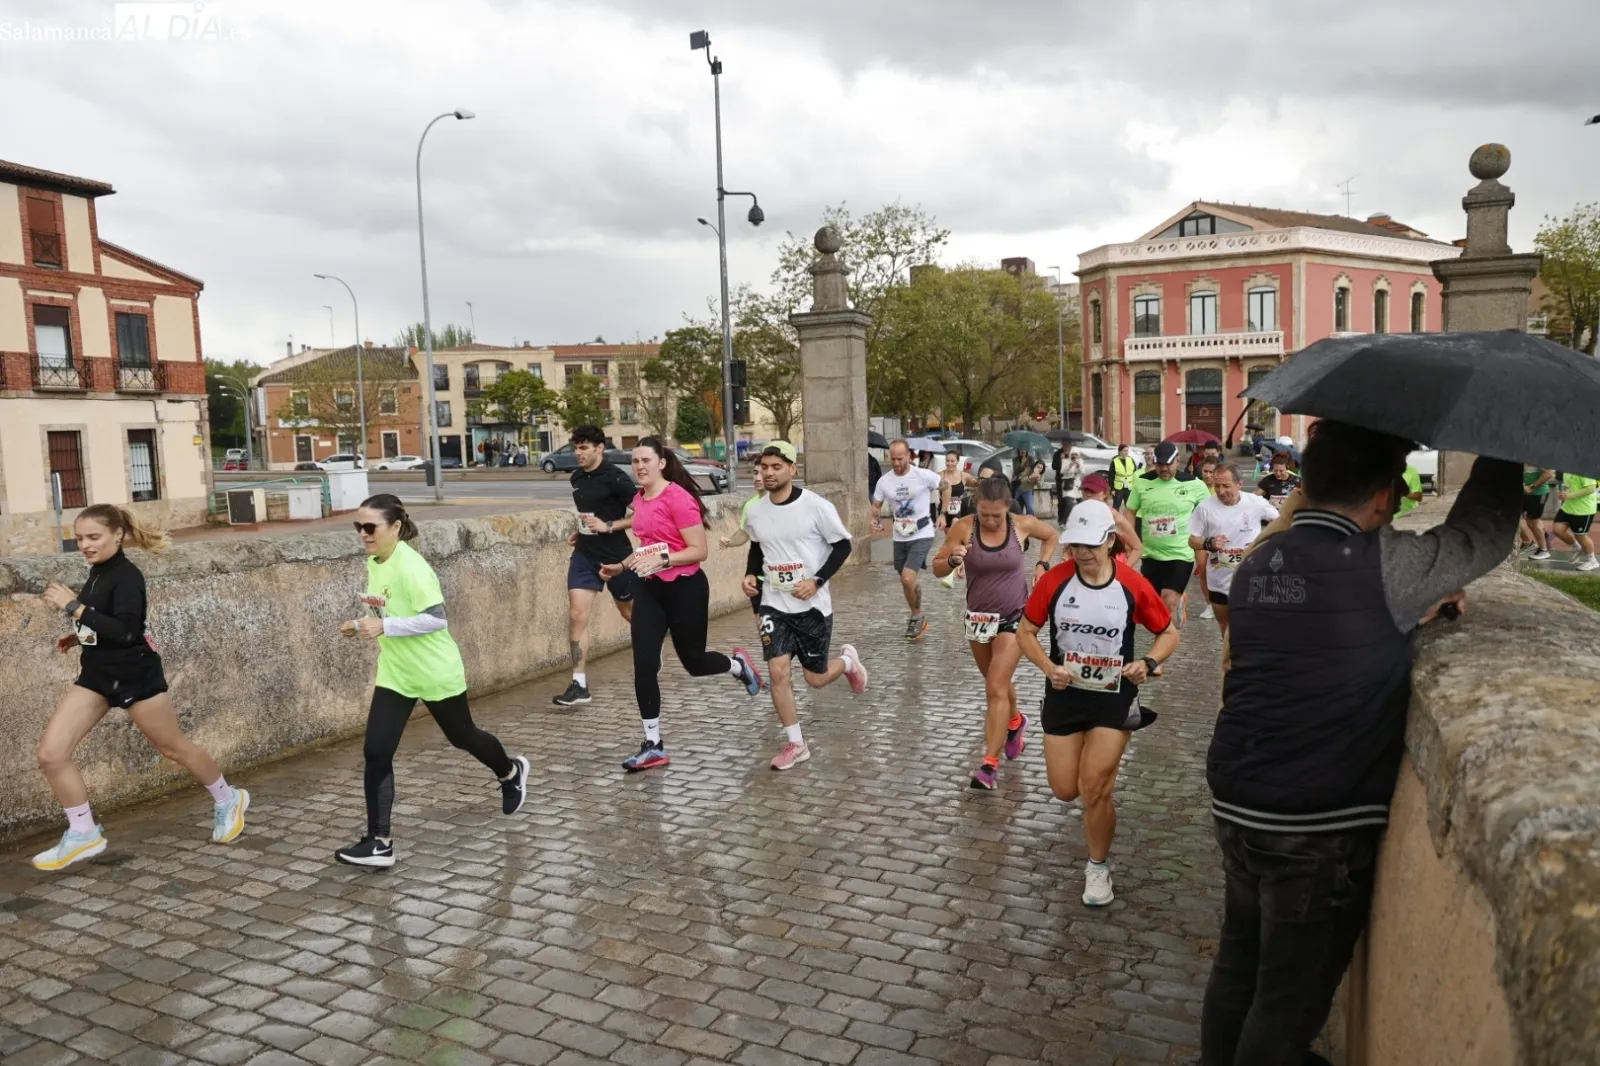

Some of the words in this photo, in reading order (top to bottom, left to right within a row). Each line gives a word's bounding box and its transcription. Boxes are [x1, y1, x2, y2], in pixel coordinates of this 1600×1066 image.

[1156, 523, 1168, 532] 42
[1228, 554, 1242, 563] 25
[778, 571, 794, 583] 53
[1247, 575, 1306, 604] PLNS
[971, 622, 988, 635] 74
[1060, 622, 1120, 638] 37300
[1066, 652, 1122, 668] bedunia
[1081, 665, 1104, 681] 84
